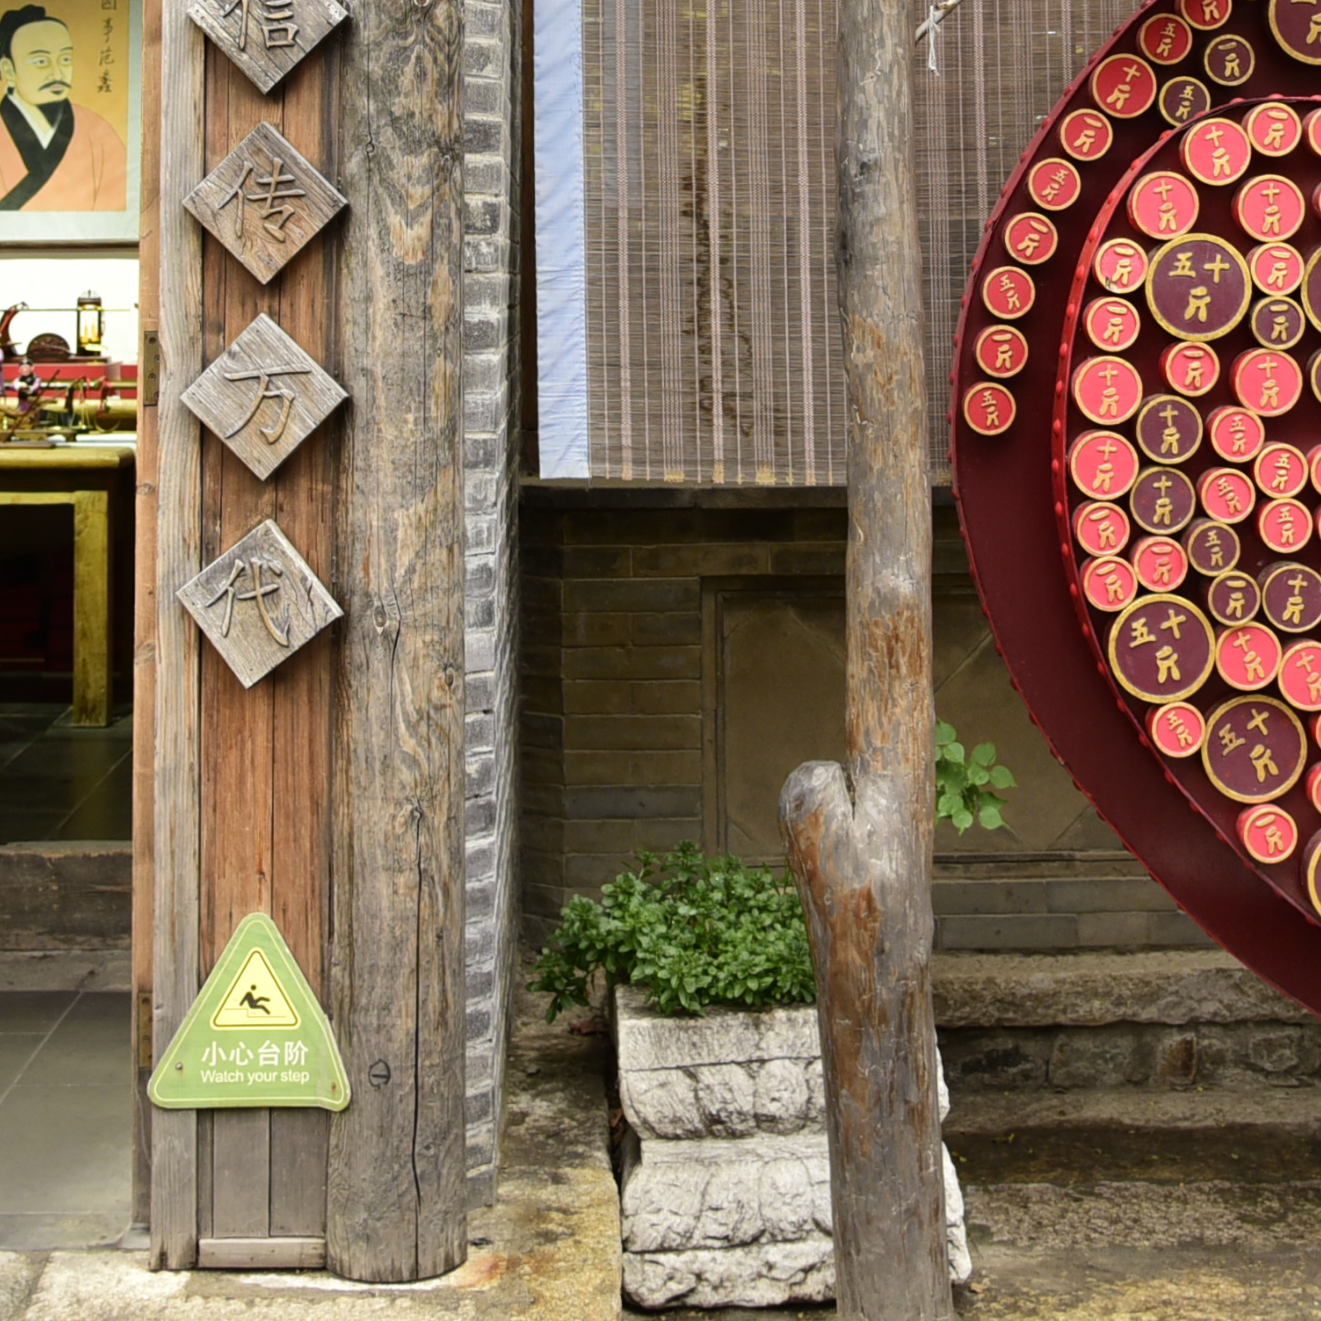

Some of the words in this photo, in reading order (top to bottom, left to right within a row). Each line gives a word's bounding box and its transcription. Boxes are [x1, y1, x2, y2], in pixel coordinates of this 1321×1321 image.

[1217, 40, 1241, 79] 一斤
[1106, 64, 1141, 110] 十斤
[1073, 117, 1103, 154] 一斤
[1263, 109, 1290, 149] 一斤
[1205, 125, 1233, 177] 十斤
[1154, 180, 1178, 231] 十斤
[1261, 183, 1283, 234] 十斤
[1017, 220, 1049, 257] 一斤
[1111, 245, 1137, 285] 一斤
[1001, 274, 1021, 310] 五斤
[1103, 305, 1128, 343] 一斤
[992, 333, 1013, 369] 一斤
[1184, 350, 1205, 388] 一斤
[981, 390, 1000, 427] 五斤
[1098, 364, 1120, 416] 十斤
[1159, 404, 1182, 456] 十斤
[1229, 416, 1247, 453] 五斤
[1092, 440, 1119, 492] 十斤
[1271, 452, 1291, 491] 五斤
[1152, 475, 1175, 527] 十斤
[1218, 477, 1243, 513] 五斤
[1090, 509, 1117, 548] 一斤
[1152, 545, 1173, 583] 一斤
[1281, 573, 1310, 626] 十斤
[1233, 631, 1266, 682] 十斤
[1167, 710, 1194, 747] 五斤
[1255, 814, 1285, 854] 一斤
[201, 1040, 309, 1067] 小心台阶
[201, 1070, 244, 1083] Watch
[247, 1072, 277, 1086] your
[280, 1070, 310, 1085] step
